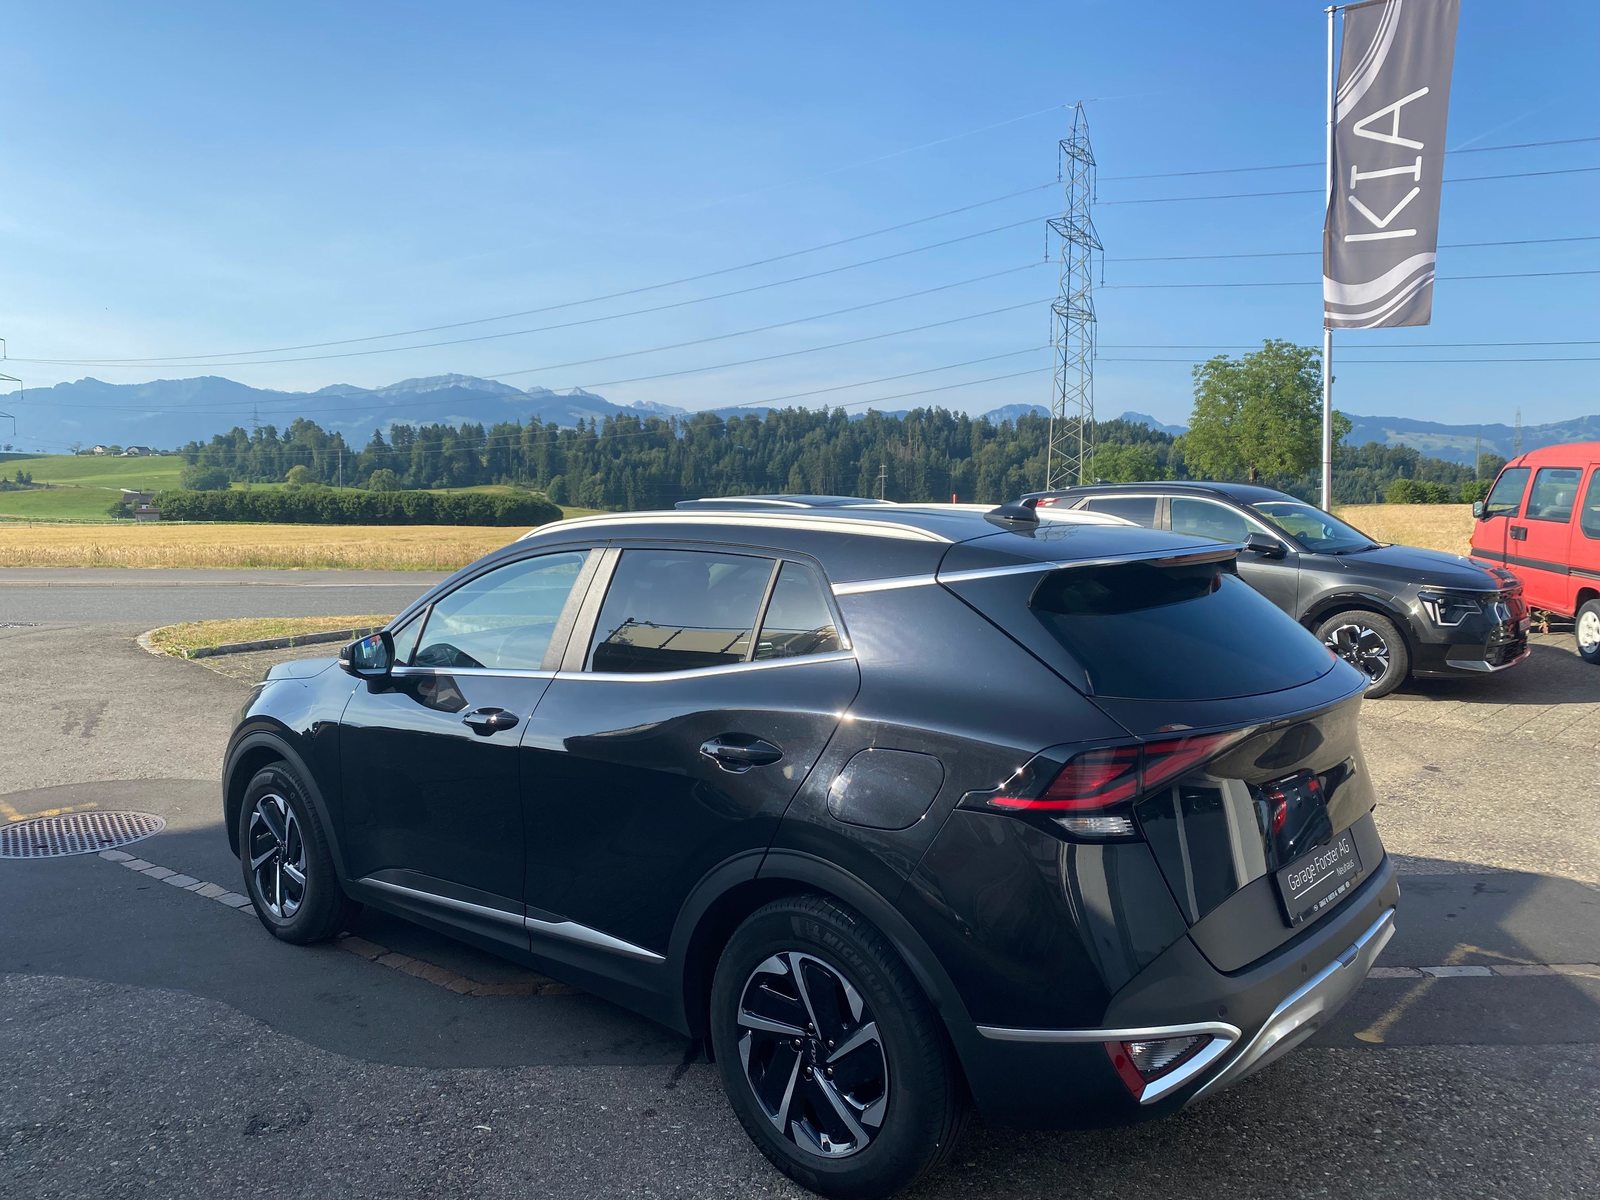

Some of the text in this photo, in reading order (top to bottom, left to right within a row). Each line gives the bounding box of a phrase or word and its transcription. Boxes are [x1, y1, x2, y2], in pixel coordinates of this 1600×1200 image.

[1344, 86, 1430, 243] KIA
[1288, 838, 1350, 890] Garage Forster AG
[1336, 859, 1355, 876] Neuhaus
